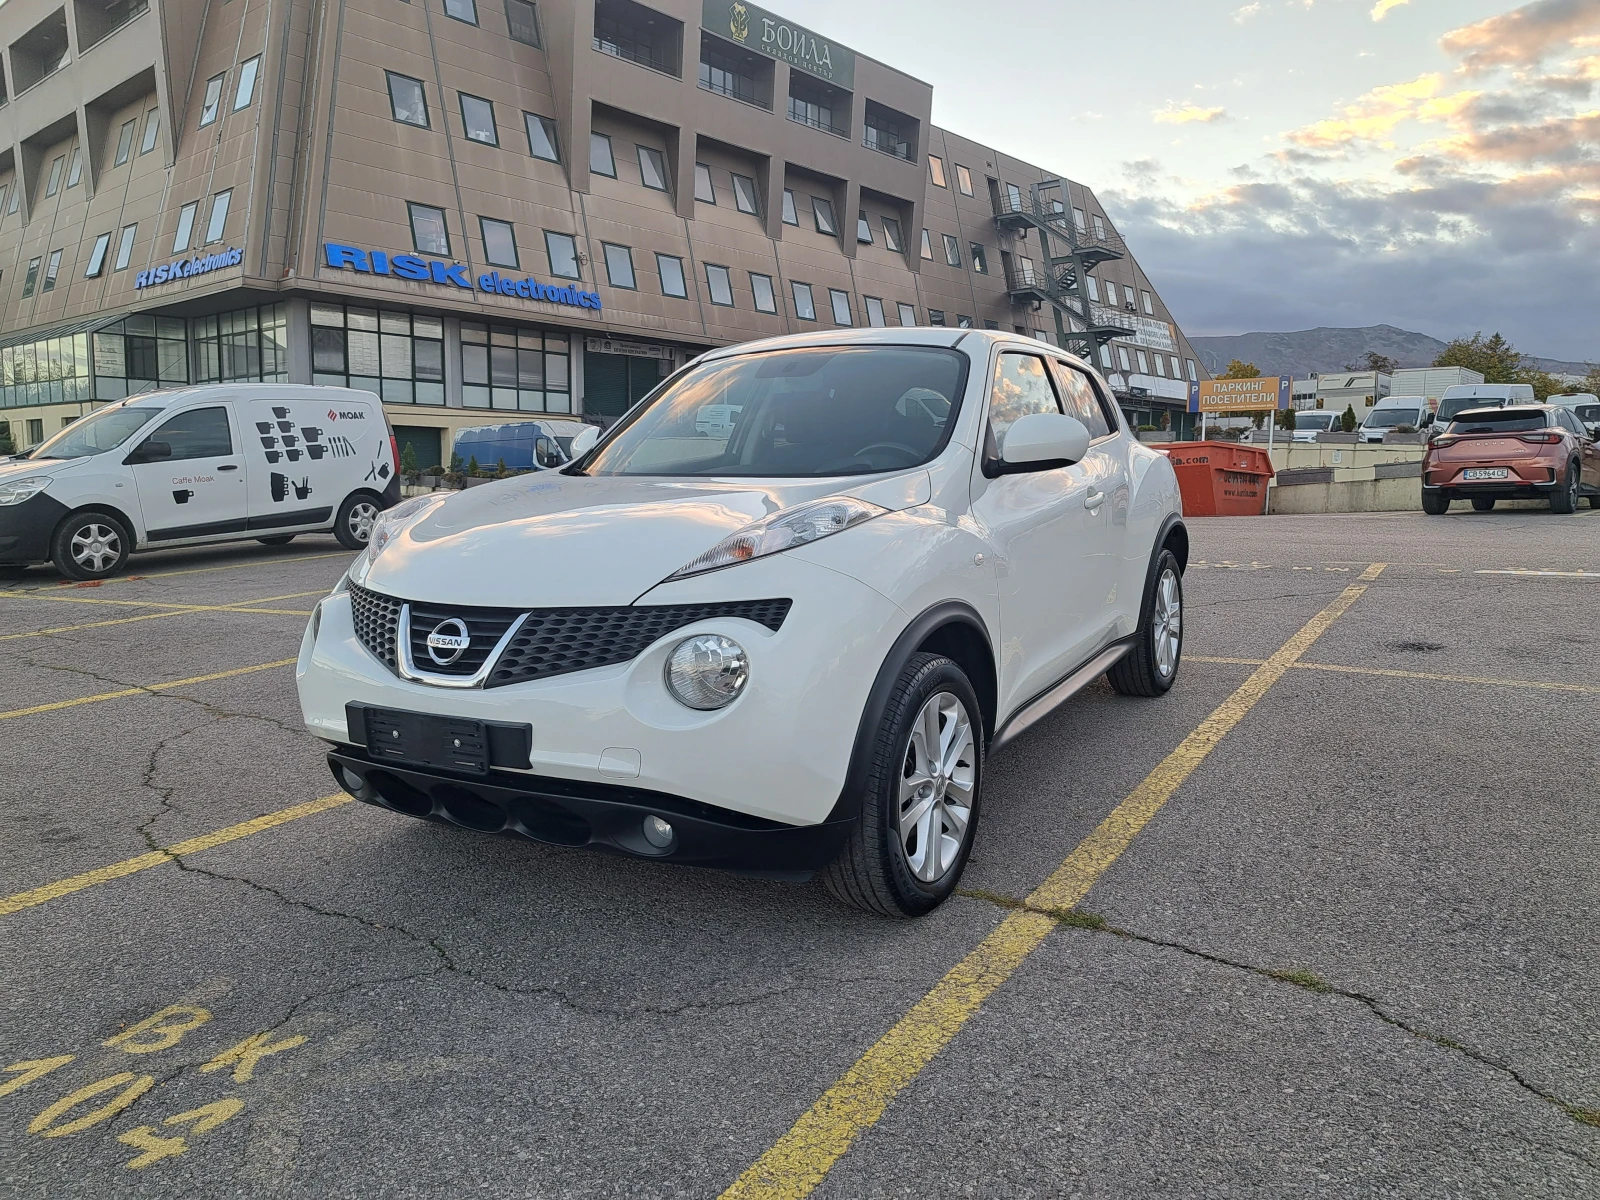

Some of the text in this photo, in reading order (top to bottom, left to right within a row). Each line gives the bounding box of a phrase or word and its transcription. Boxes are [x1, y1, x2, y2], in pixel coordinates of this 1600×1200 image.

[761, 17, 833, 70] БОИЛА
[133, 245, 244, 290] RISK electronics
[323, 242, 602, 311] RISK electronics
[1191, 385, 1199, 395] P
[1213, 381, 1265, 393] ПАРКИНГ
[1281, 380, 1289, 390] P
[1202, 392, 1275, 405] ПОСЕТИТЕЛИ
[339, 410, 366, 420] MOAK
[1172, 456, 1209, 466] ia.com
[171, 475, 215, 485] Caffe Moak
[427, 636, 463, 647] NISSAN
